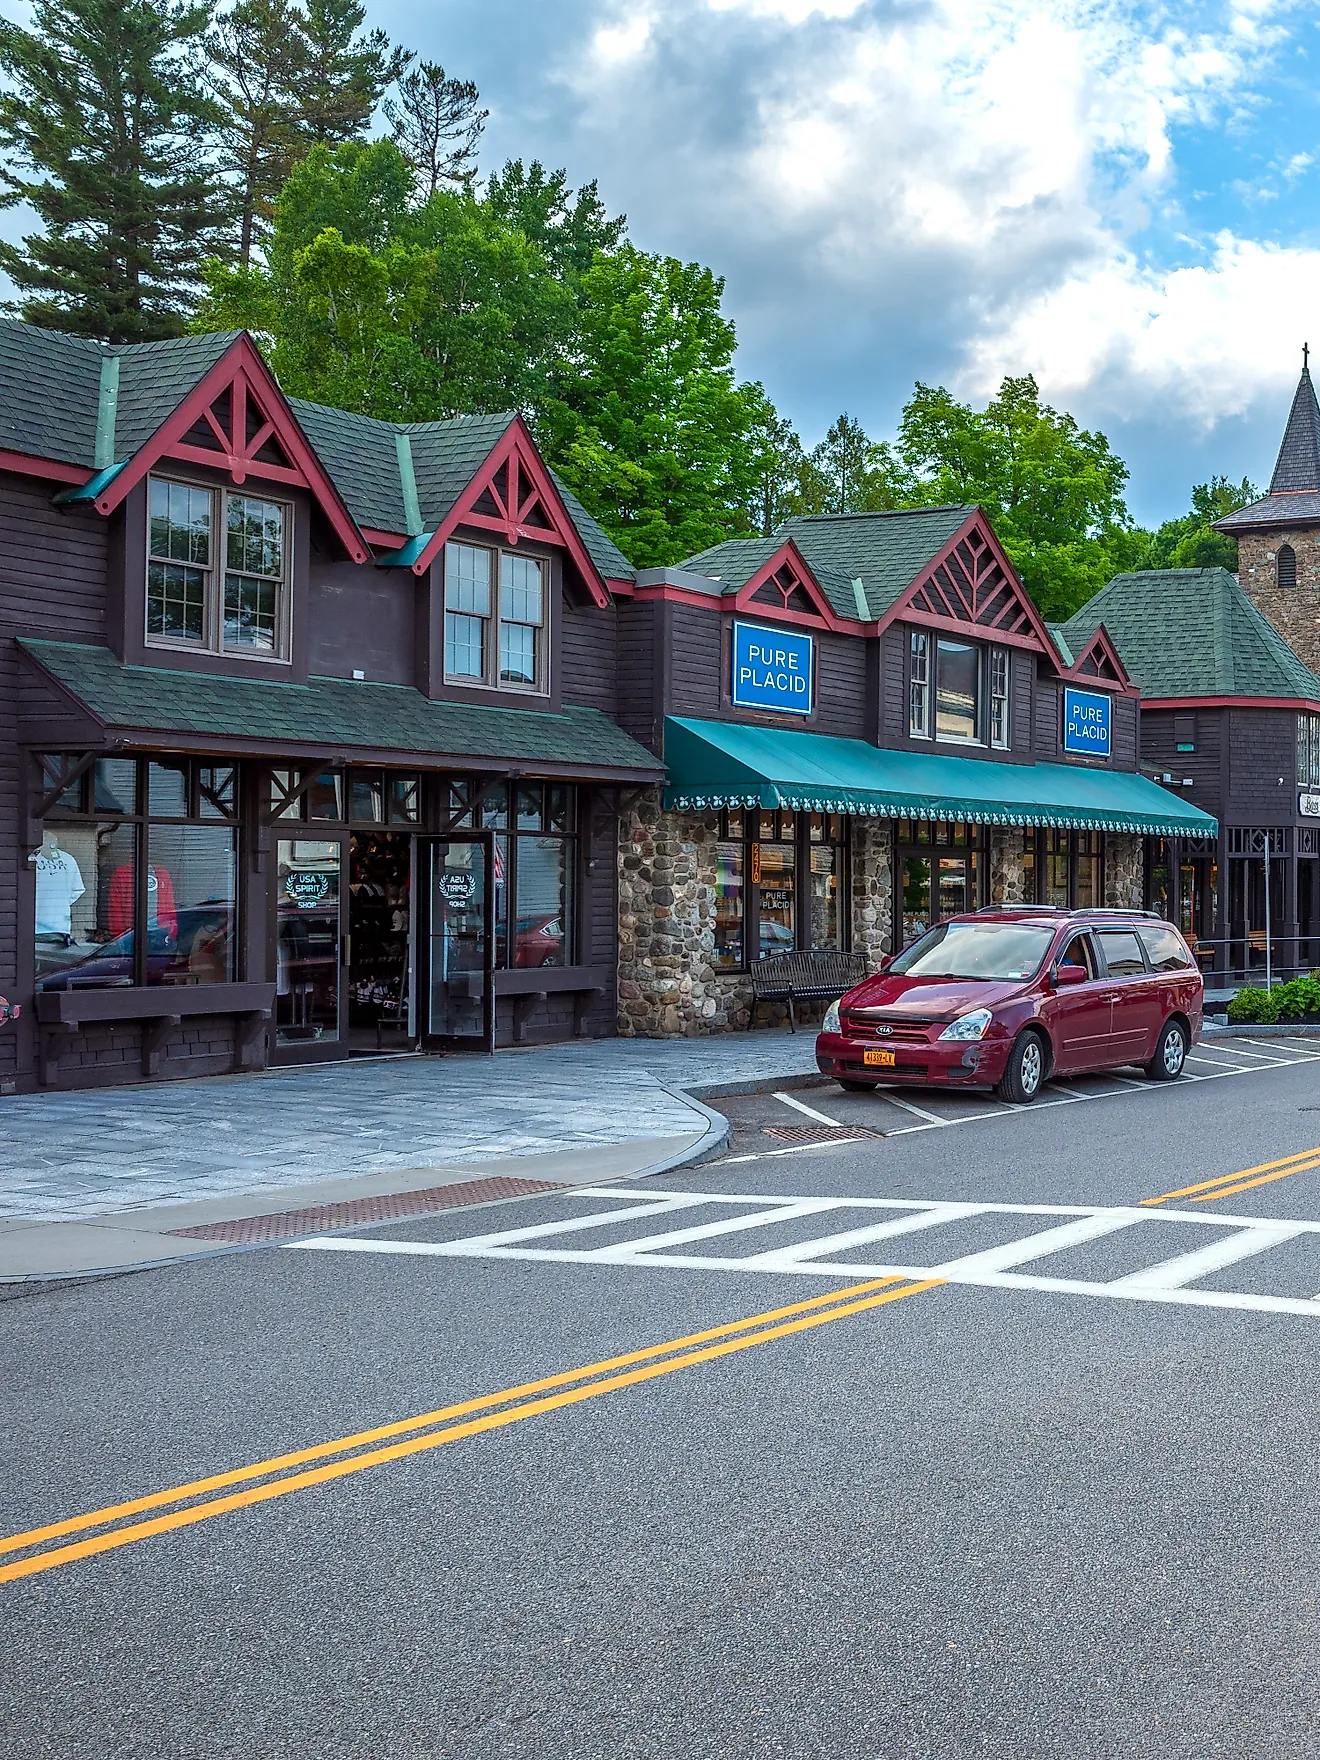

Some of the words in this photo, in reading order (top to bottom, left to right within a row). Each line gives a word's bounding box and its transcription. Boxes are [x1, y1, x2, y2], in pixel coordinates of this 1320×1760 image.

[749, 644, 799, 670] PURE
[740, 666, 806, 693] PLACID
[1073, 704, 1103, 723] PURE
[1068, 721, 1107, 740] PLACID
[299, 875, 317, 883] USA
[295, 884, 321, 893] SPIRIT
[765, 891, 787, 900] PURE
[297, 901, 317, 909] SHOP
[762, 901, 790, 909] PLACID
